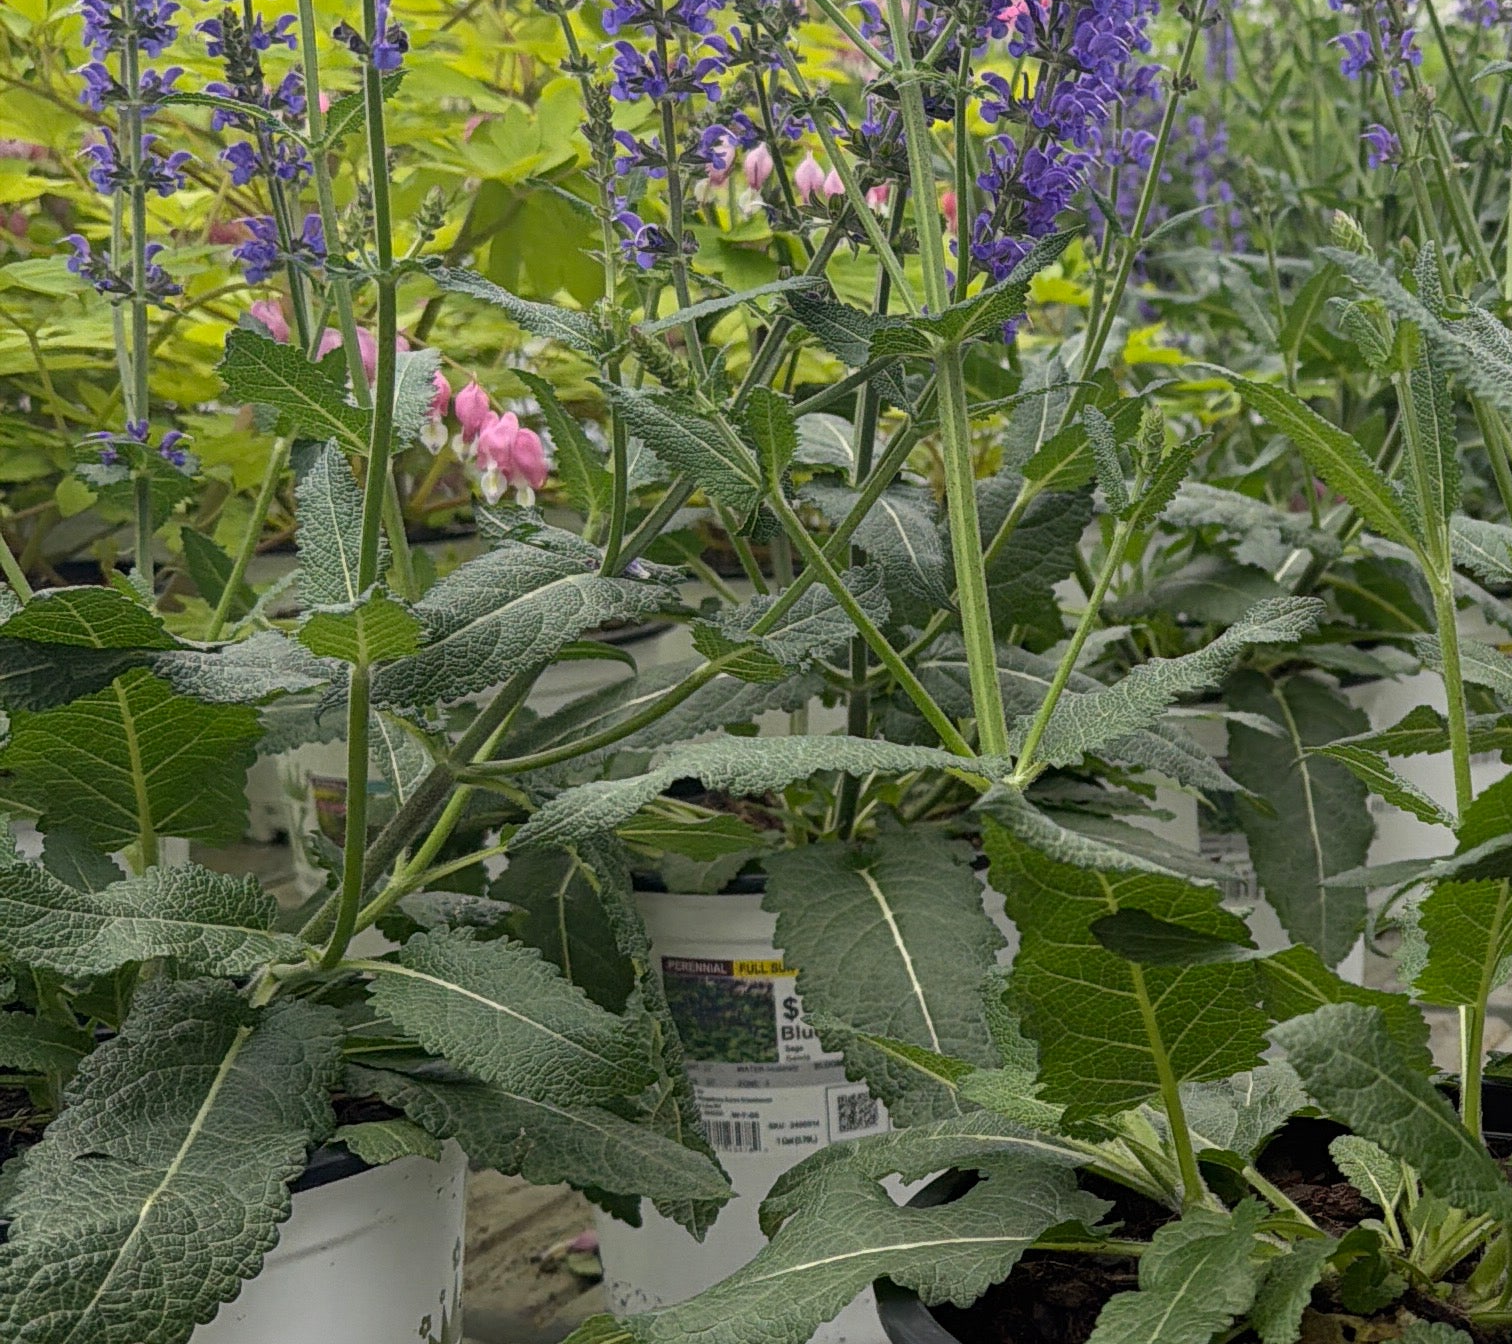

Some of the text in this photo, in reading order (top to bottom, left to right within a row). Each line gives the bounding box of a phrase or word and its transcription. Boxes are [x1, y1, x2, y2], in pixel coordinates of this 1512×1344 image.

[667, 961, 728, 975] PERENNIAL
[739, 962, 769, 975] FULL
[781, 1024, 819, 1041] Blu
